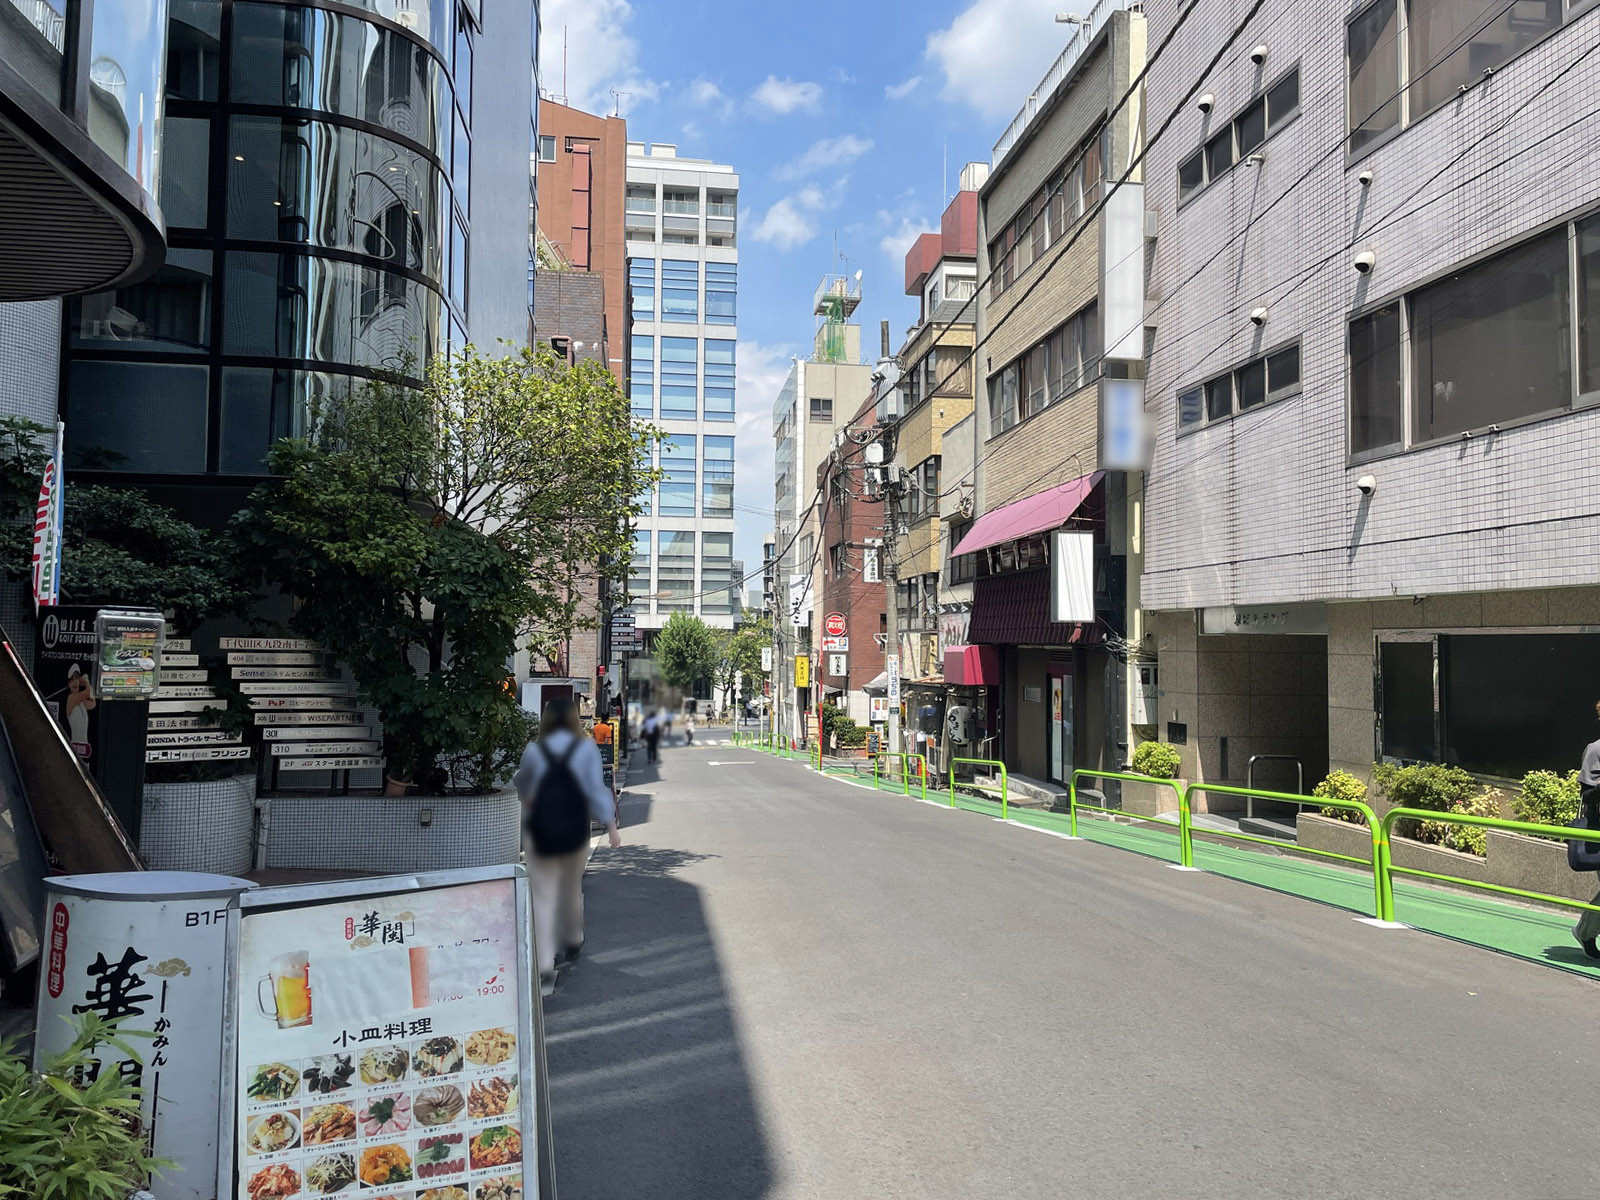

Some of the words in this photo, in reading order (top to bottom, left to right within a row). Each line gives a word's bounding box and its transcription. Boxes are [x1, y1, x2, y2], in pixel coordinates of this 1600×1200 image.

[60, 619, 86, 631] WISE
[59, 634, 75, 644] GOLF
[177, 735, 204, 743] トラベル
[265, 729, 278, 738] 301
[210, 749, 248, 758] フリック
[275, 745, 290, 753] 310
[186, 909, 226, 927] B1F
[50, 911, 66, 993] 中華料理
[477, 984, 505, 997] 19:00
[332, 1017, 433, 1048] 小皿料理
[151, 1016, 171, 1067] かみん
